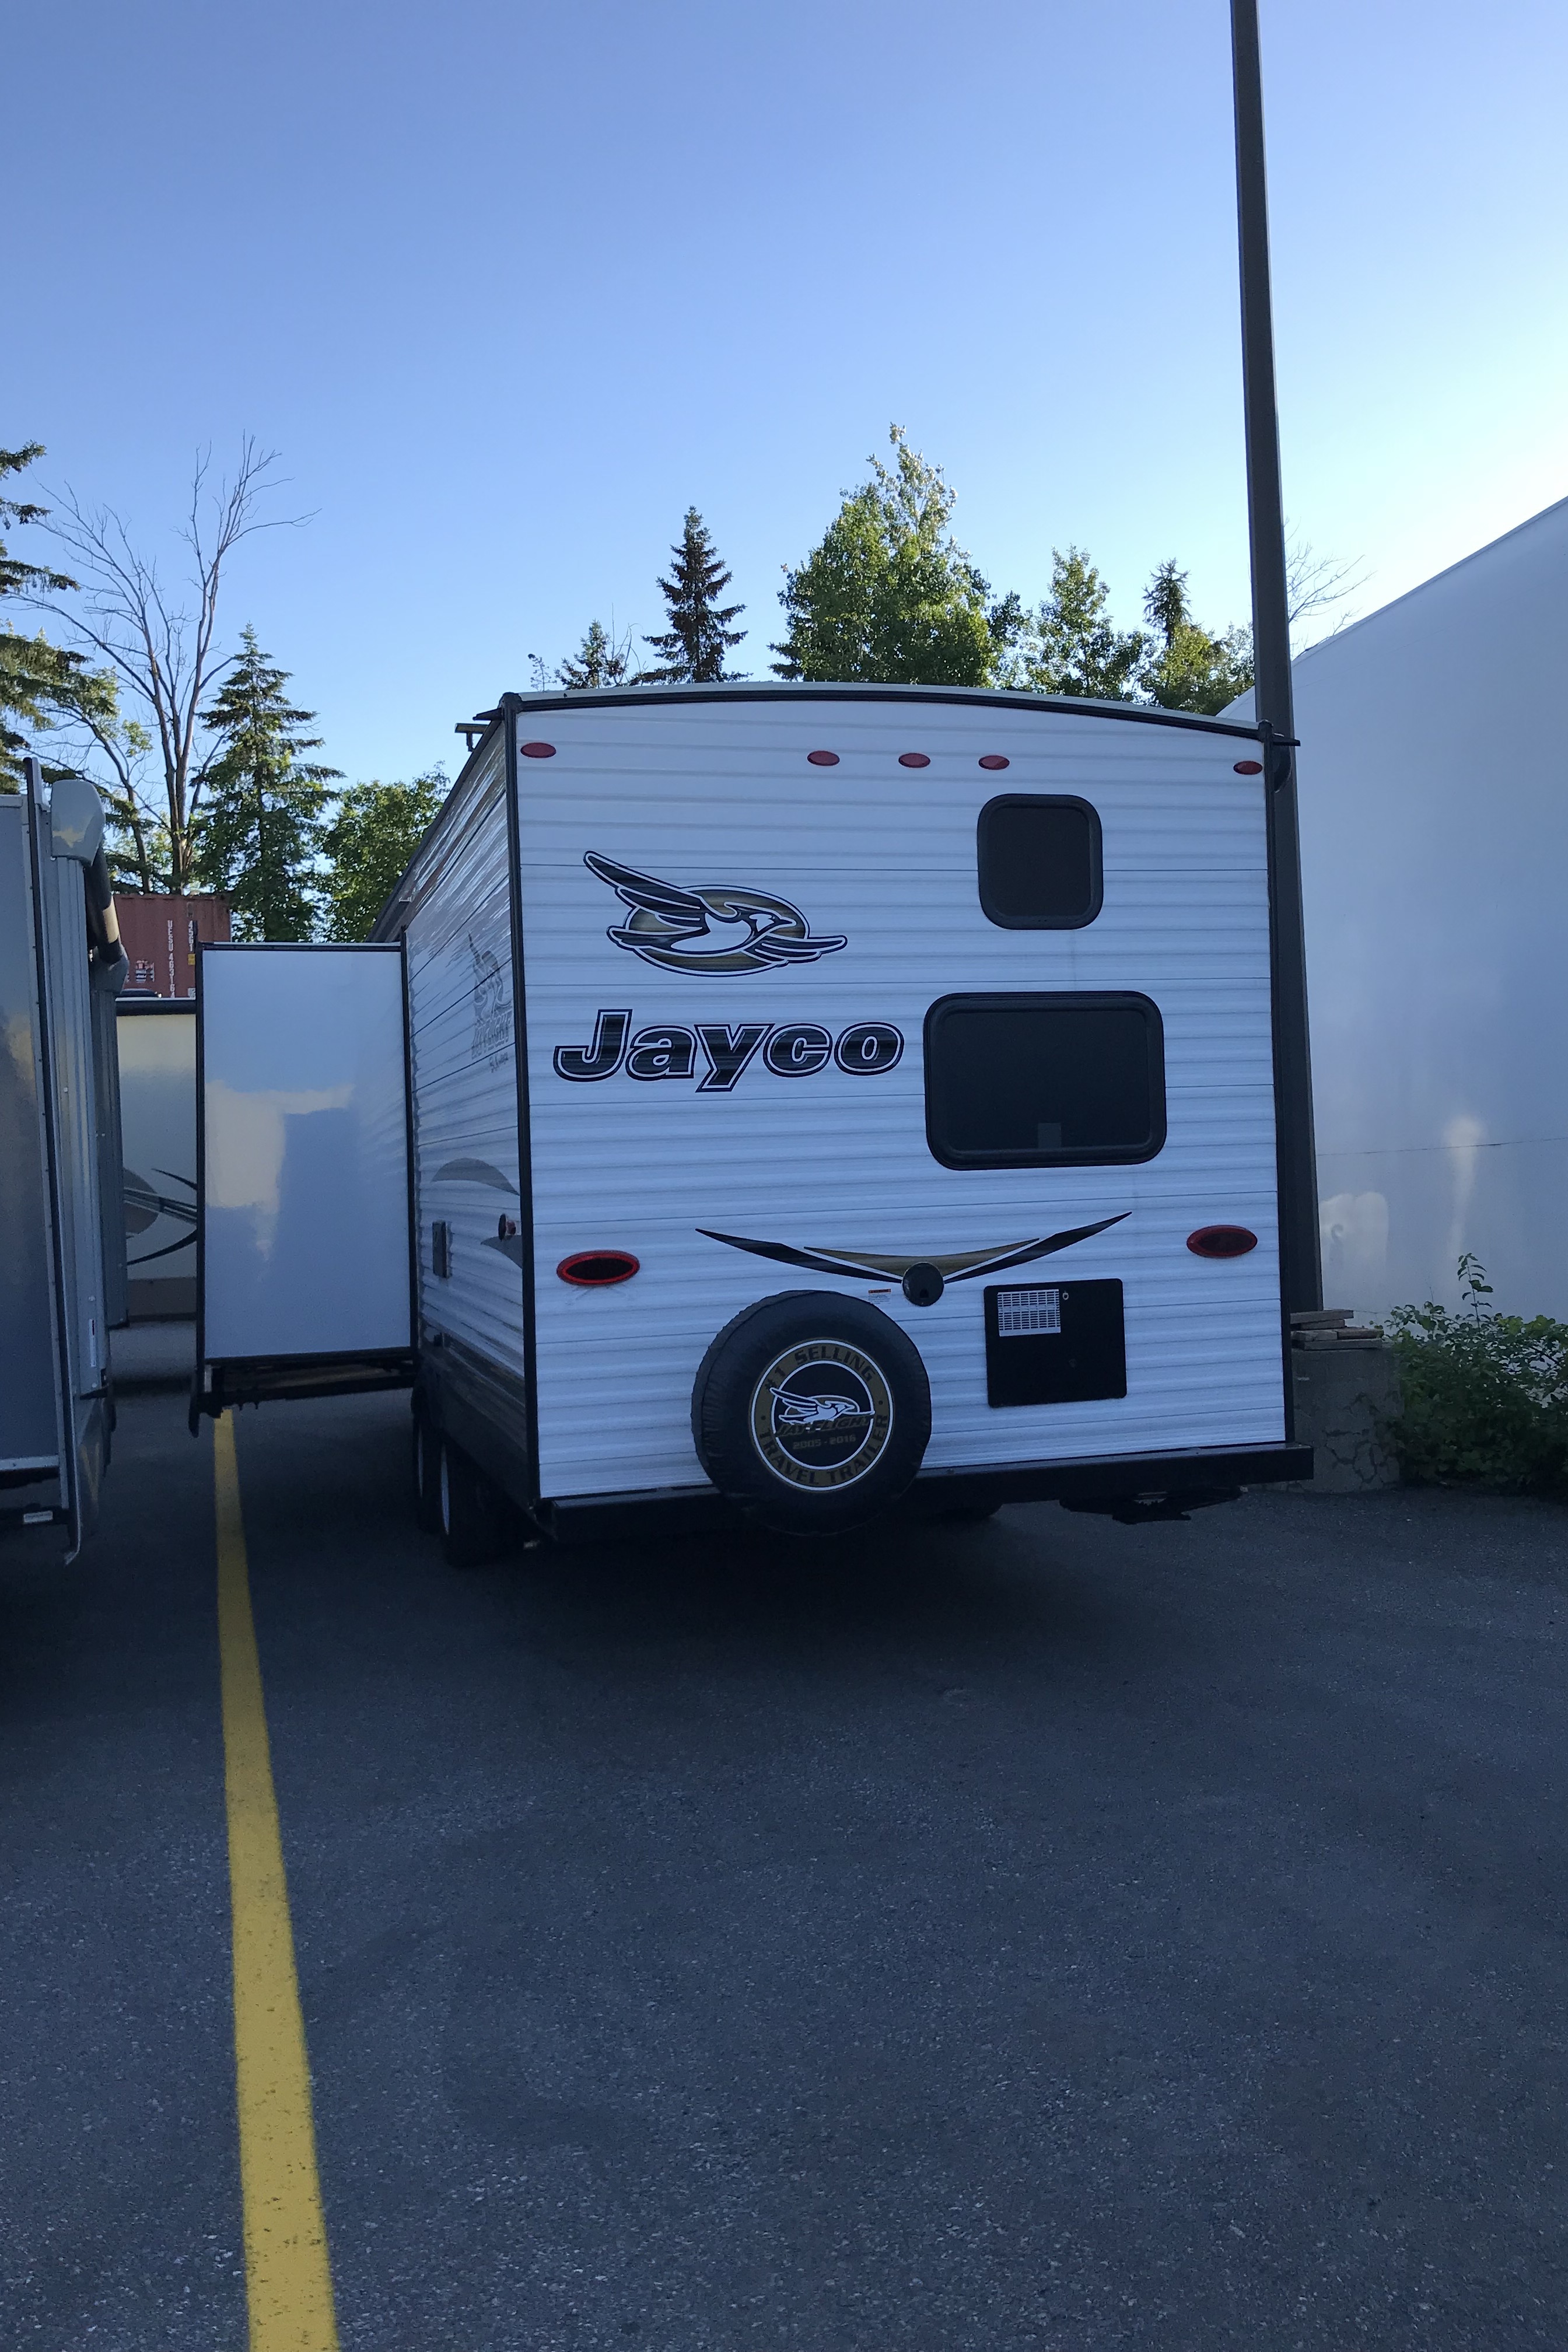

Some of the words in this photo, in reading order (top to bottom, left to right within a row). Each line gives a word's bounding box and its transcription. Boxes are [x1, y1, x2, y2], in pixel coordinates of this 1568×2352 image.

[554, 1009, 904, 1093] Jayco
[794, 1346, 876, 1382] SELLING
[760, 1429, 819, 1485] TRAVEL
[827, 1415, 888, 1483] TRAILER
[829, 1434, 856, 1446] 2016
